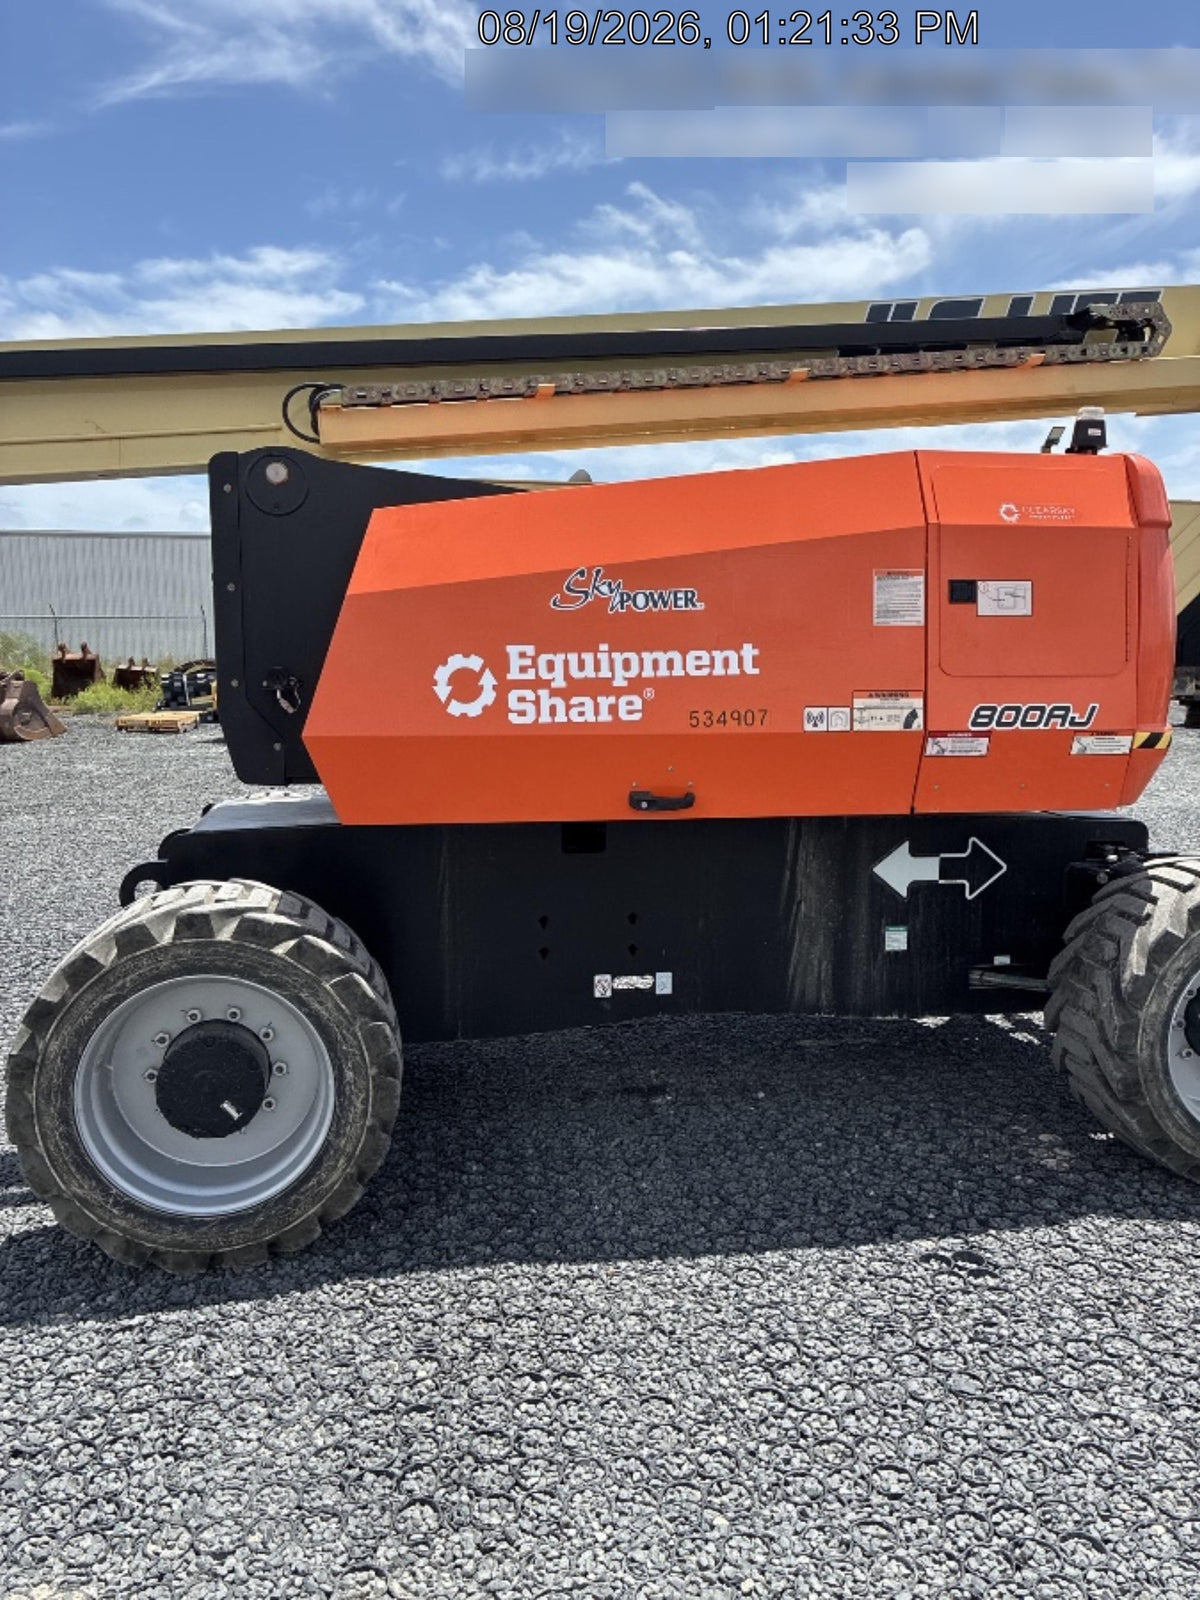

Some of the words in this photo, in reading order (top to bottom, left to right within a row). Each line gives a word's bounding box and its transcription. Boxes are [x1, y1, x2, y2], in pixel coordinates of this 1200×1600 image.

[506, 643, 760, 688] Equipment
[688, 709, 769, 728] 534907
[969, 703, 1099, 730] 800AJ
